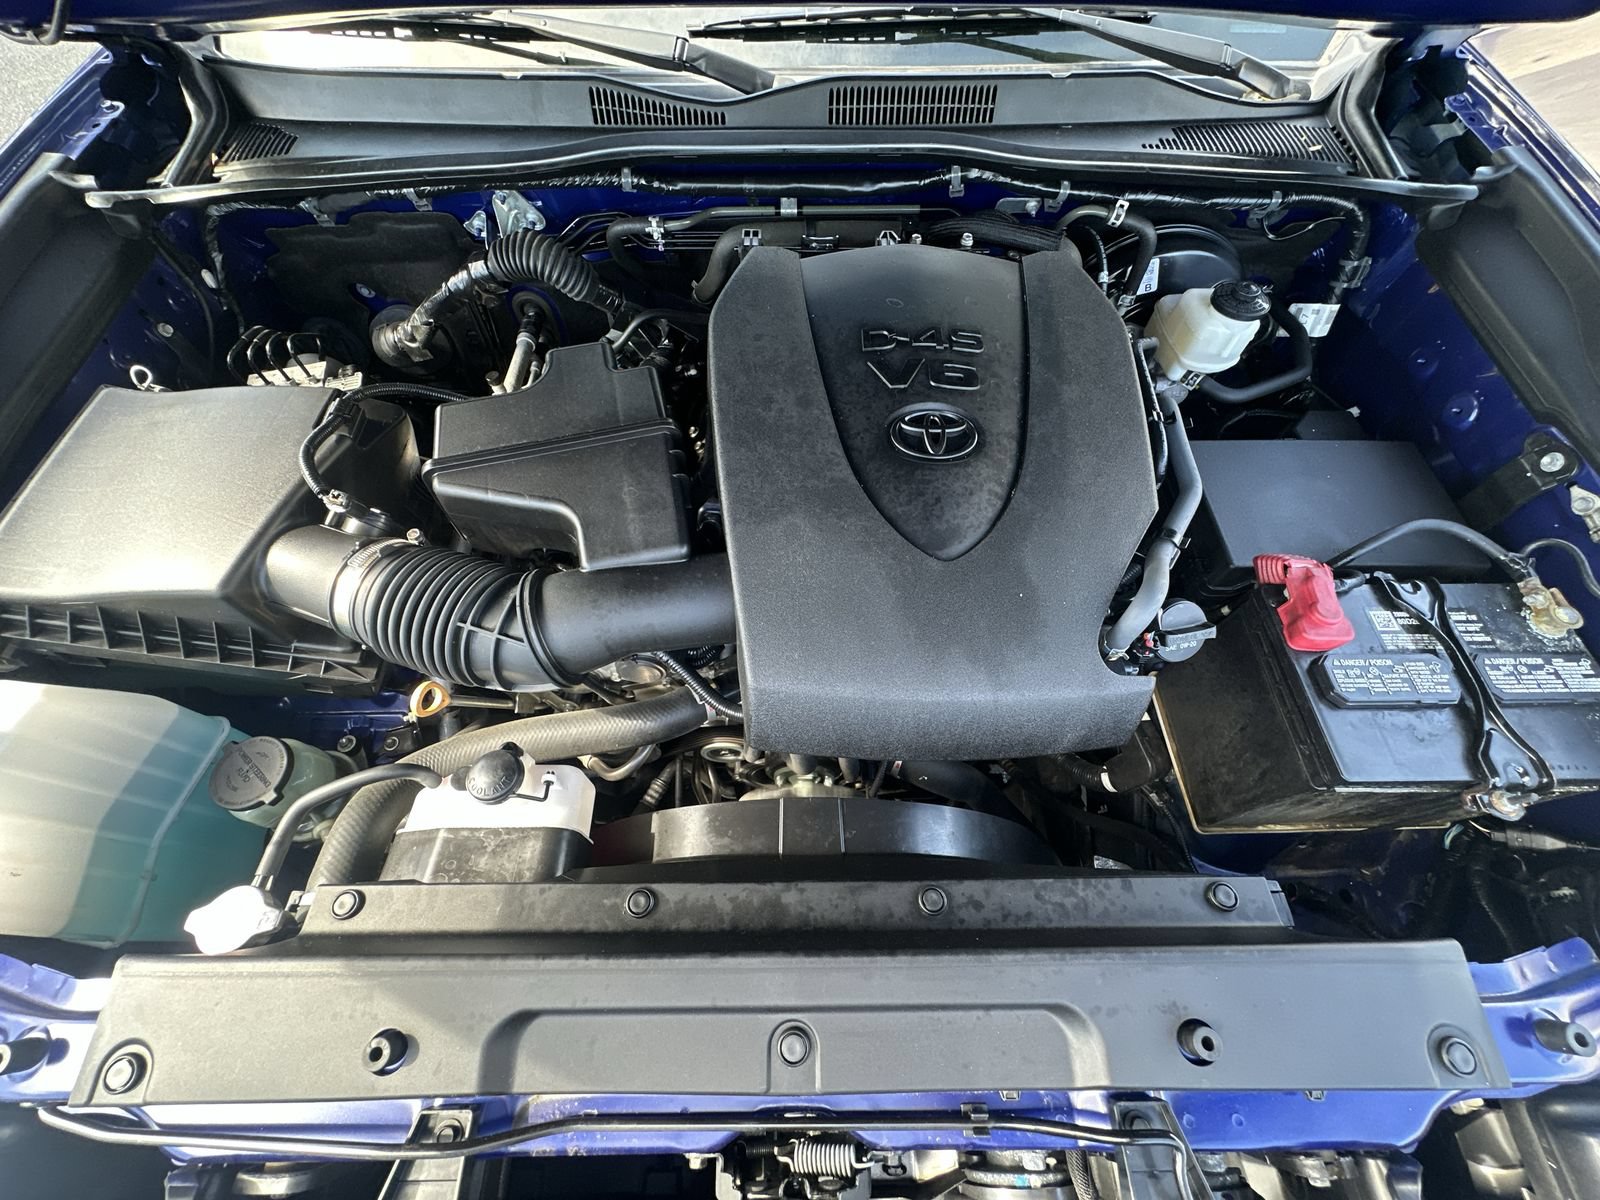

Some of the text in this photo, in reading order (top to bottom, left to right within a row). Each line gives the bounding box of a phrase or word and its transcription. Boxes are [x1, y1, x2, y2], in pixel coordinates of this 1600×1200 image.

[1144, 283, 1152, 292] B
[860, 327, 986, 354] D-4S
[866, 357, 982, 391] V6
[1340, 658, 1365, 666] DANGER
[1369, 658, 1393, 666] POISON
[1490, 657, 1516, 665] DANGER
[249, 763, 271, 788] STEERING
[468, 775, 512, 797] COOLANT
